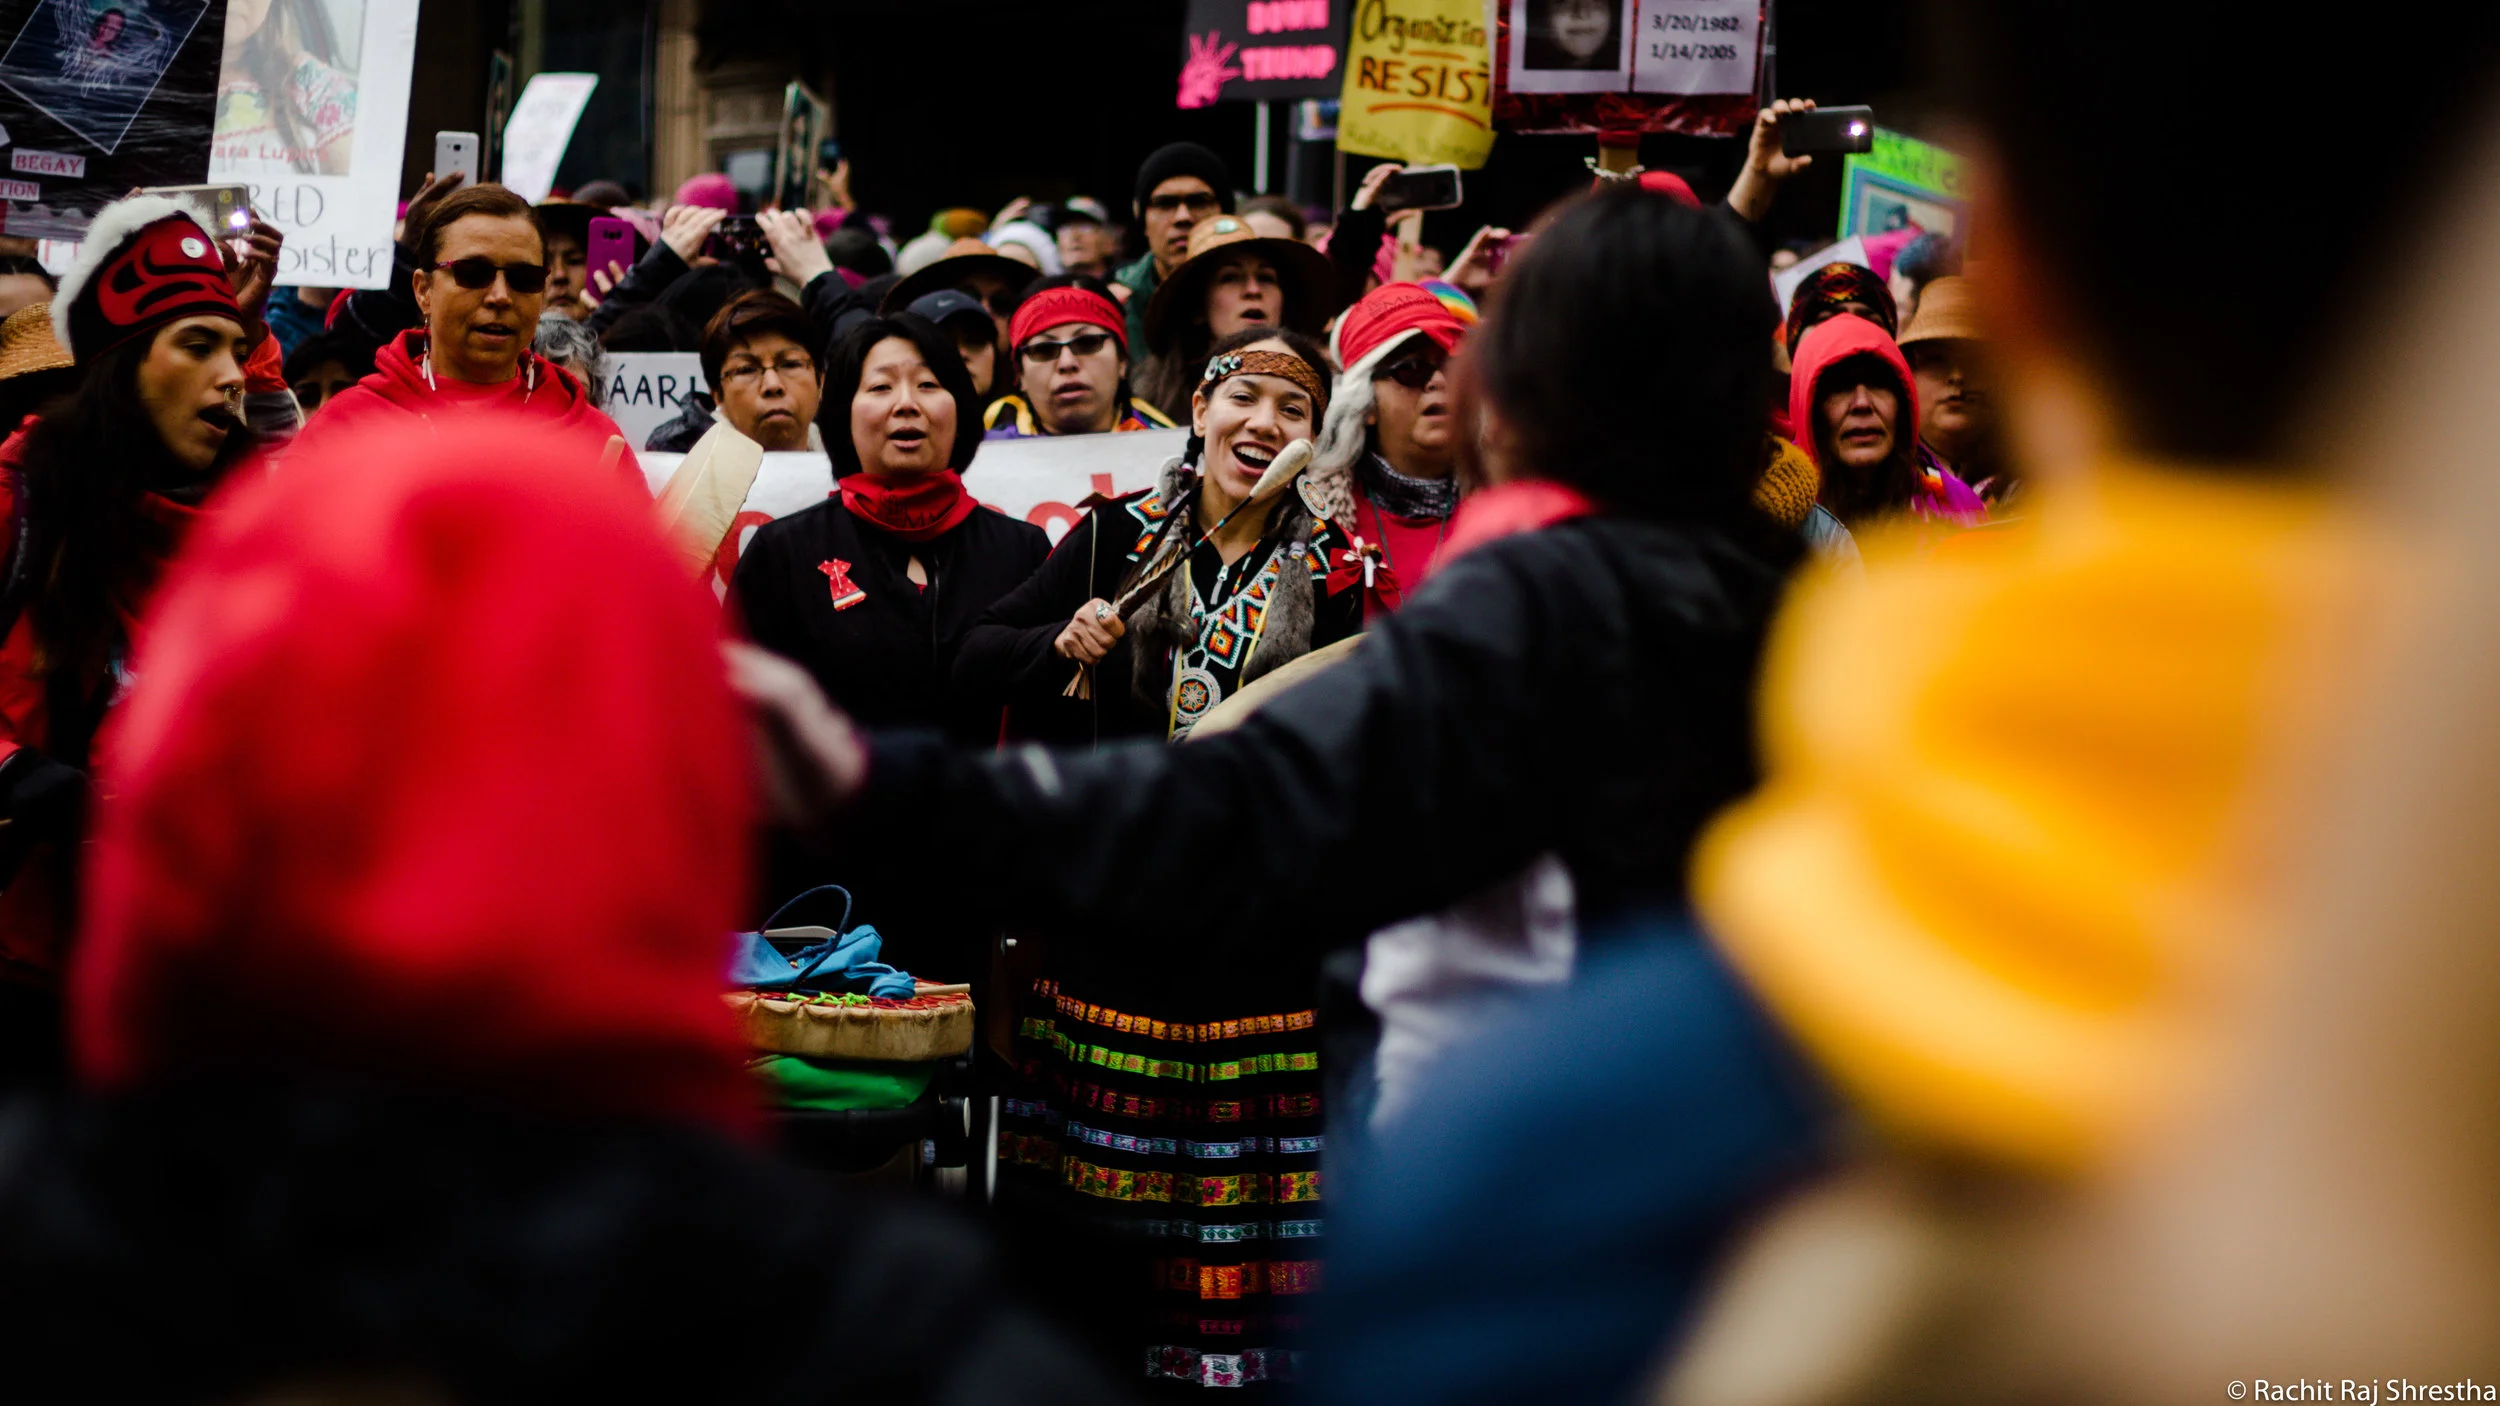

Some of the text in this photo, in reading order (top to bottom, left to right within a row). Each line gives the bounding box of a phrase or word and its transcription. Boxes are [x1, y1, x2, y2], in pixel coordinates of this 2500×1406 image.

[1652, 14, 1740, 32] 3/20/1982
[1651, 43, 1737, 60] 1/14/2005
[1240, 44, 1337, 81] TRUMP
[1358, 55, 1490, 107] RESIST
[14, 154, 82, 175] BEGAY
